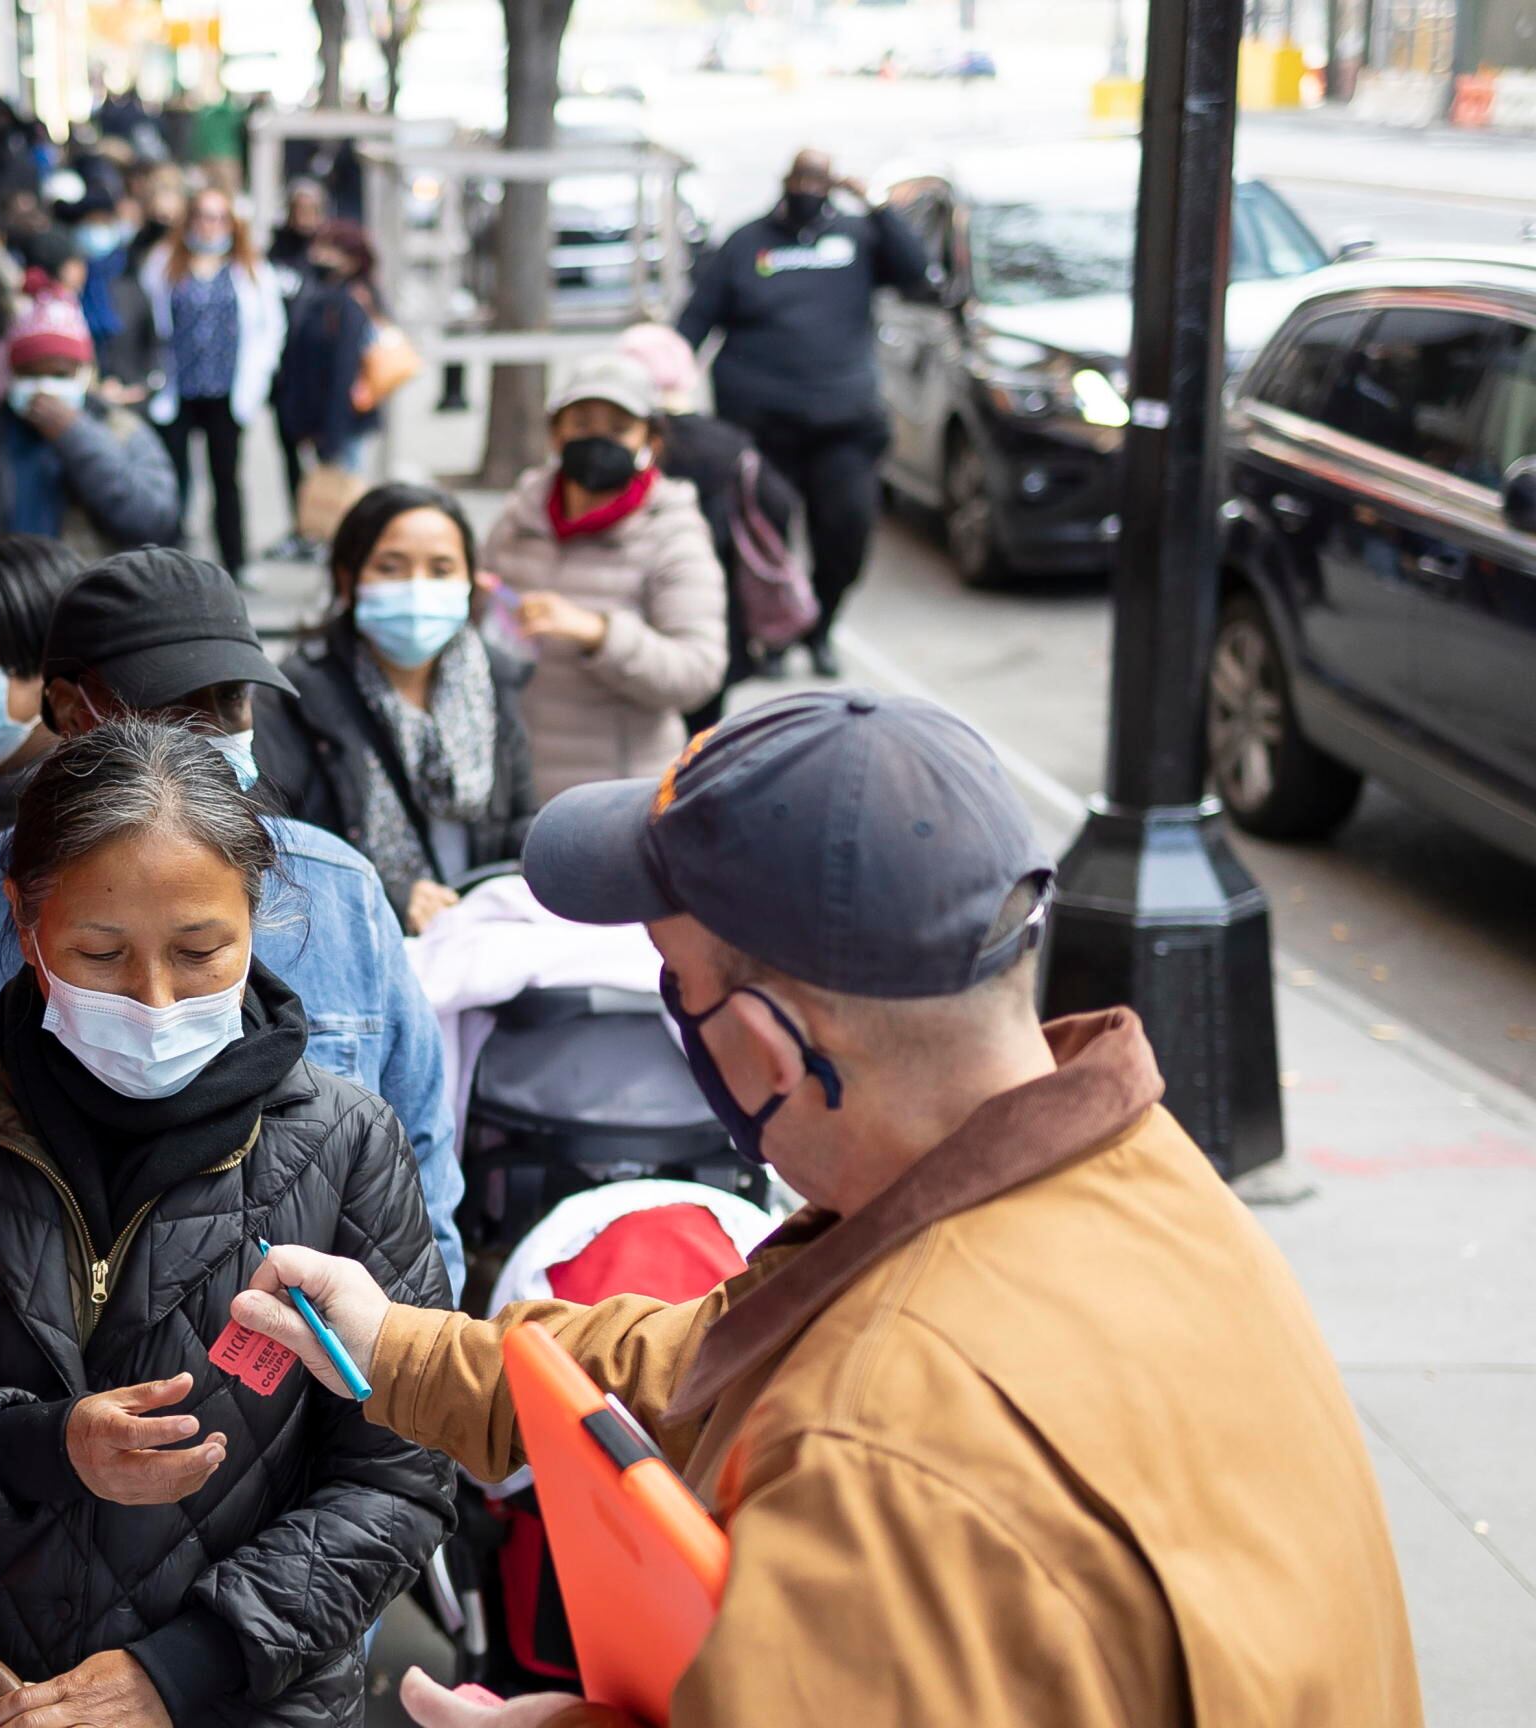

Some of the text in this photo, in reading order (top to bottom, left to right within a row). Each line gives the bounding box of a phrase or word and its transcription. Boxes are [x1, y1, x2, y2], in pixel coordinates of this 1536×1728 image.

[221, 1326, 255, 1362] TICKE
[252, 1341, 275, 1372] KEEP
[264, 1352, 279, 1369] THIS
[261, 1350, 290, 1388] COUPO
